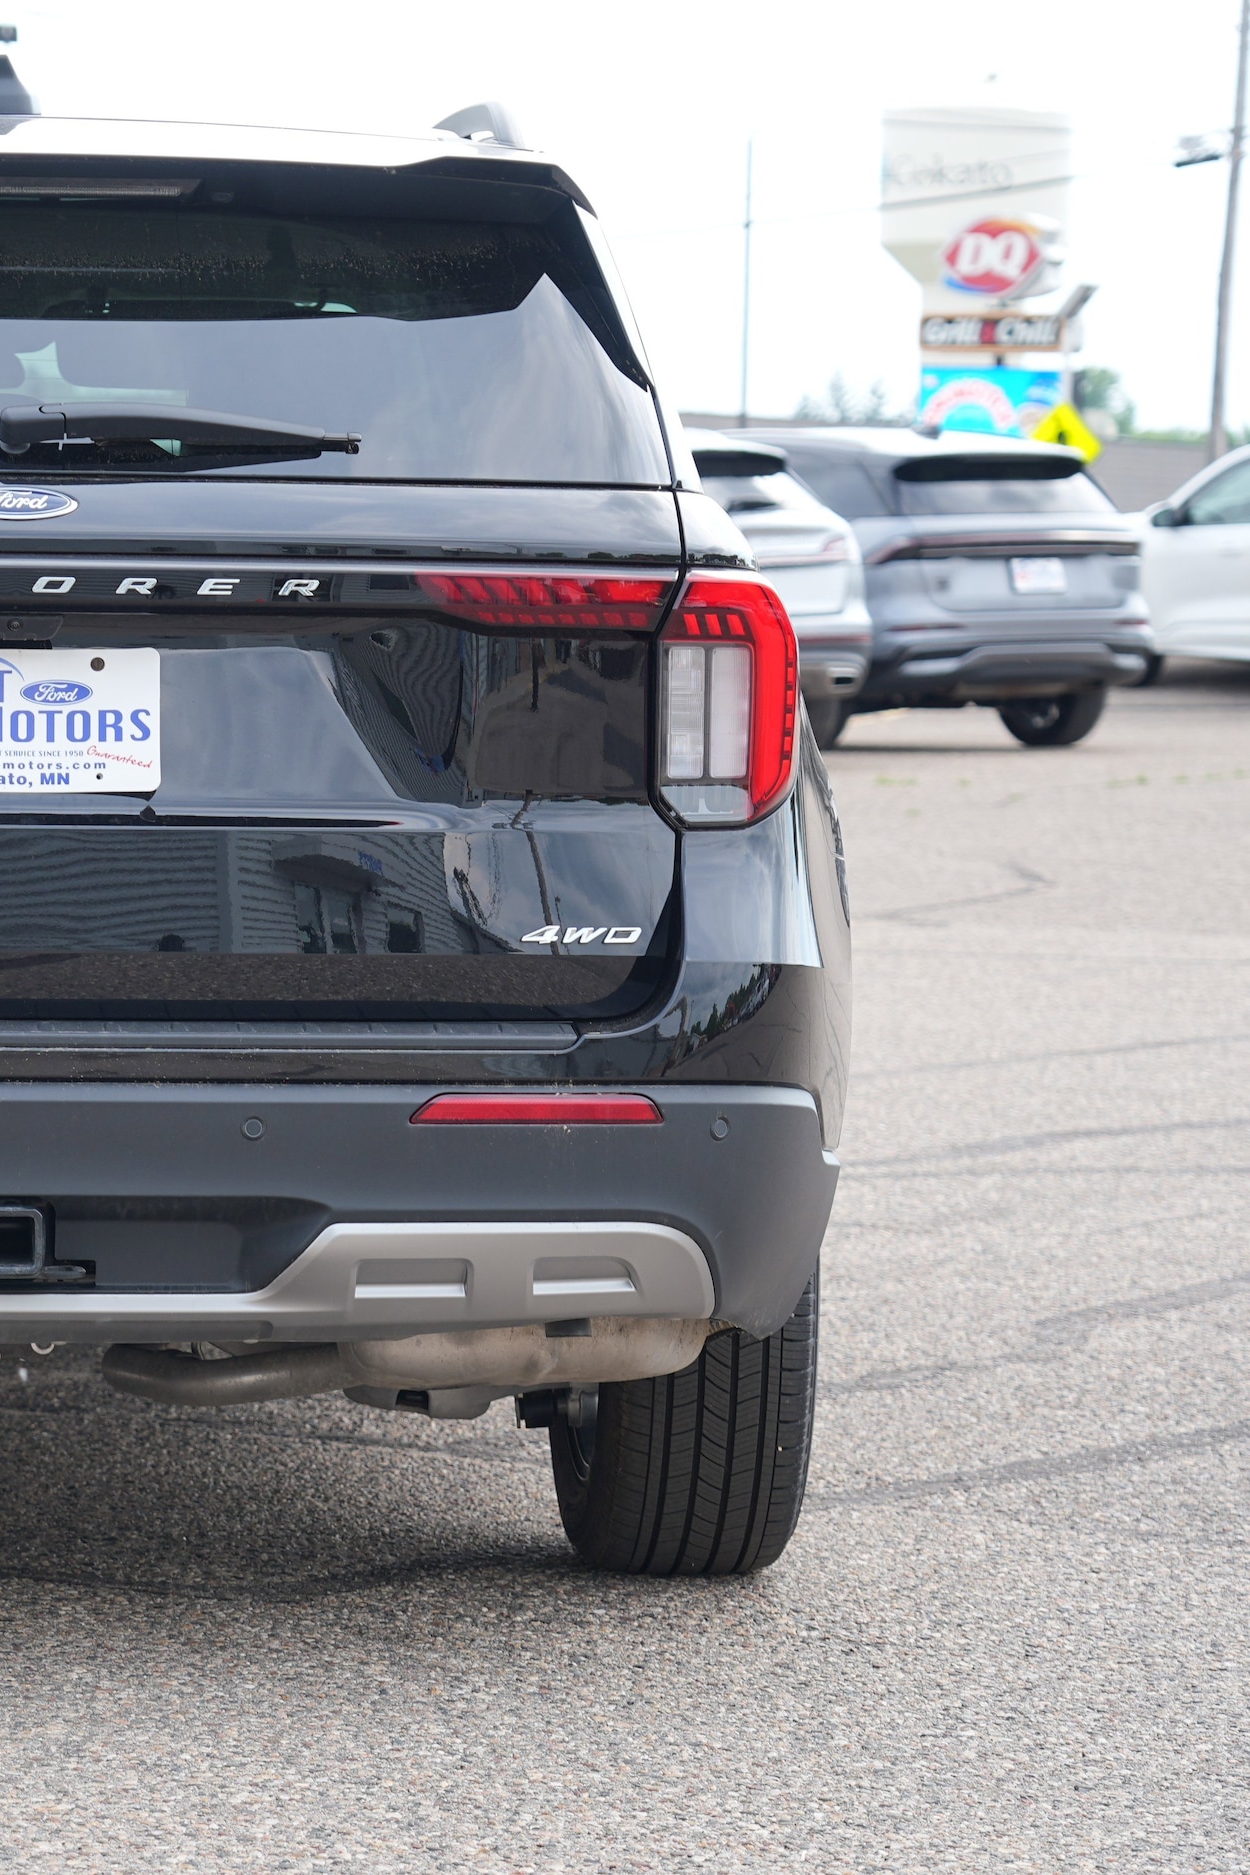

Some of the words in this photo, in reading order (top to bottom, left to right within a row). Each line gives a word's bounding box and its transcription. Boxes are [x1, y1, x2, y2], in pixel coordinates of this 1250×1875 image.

[955, 230, 1030, 279] DQ
[34, 683, 79, 702] Ford
[4, 750, 36, 758] SERVICE
[38, 750, 61, 758] SINCE
[64, 750, 84, 758] 1950
[86, 745, 153, 769] Guaranteed
[40, 772, 70, 785] MN
[520, 924, 642, 945] 4WD
